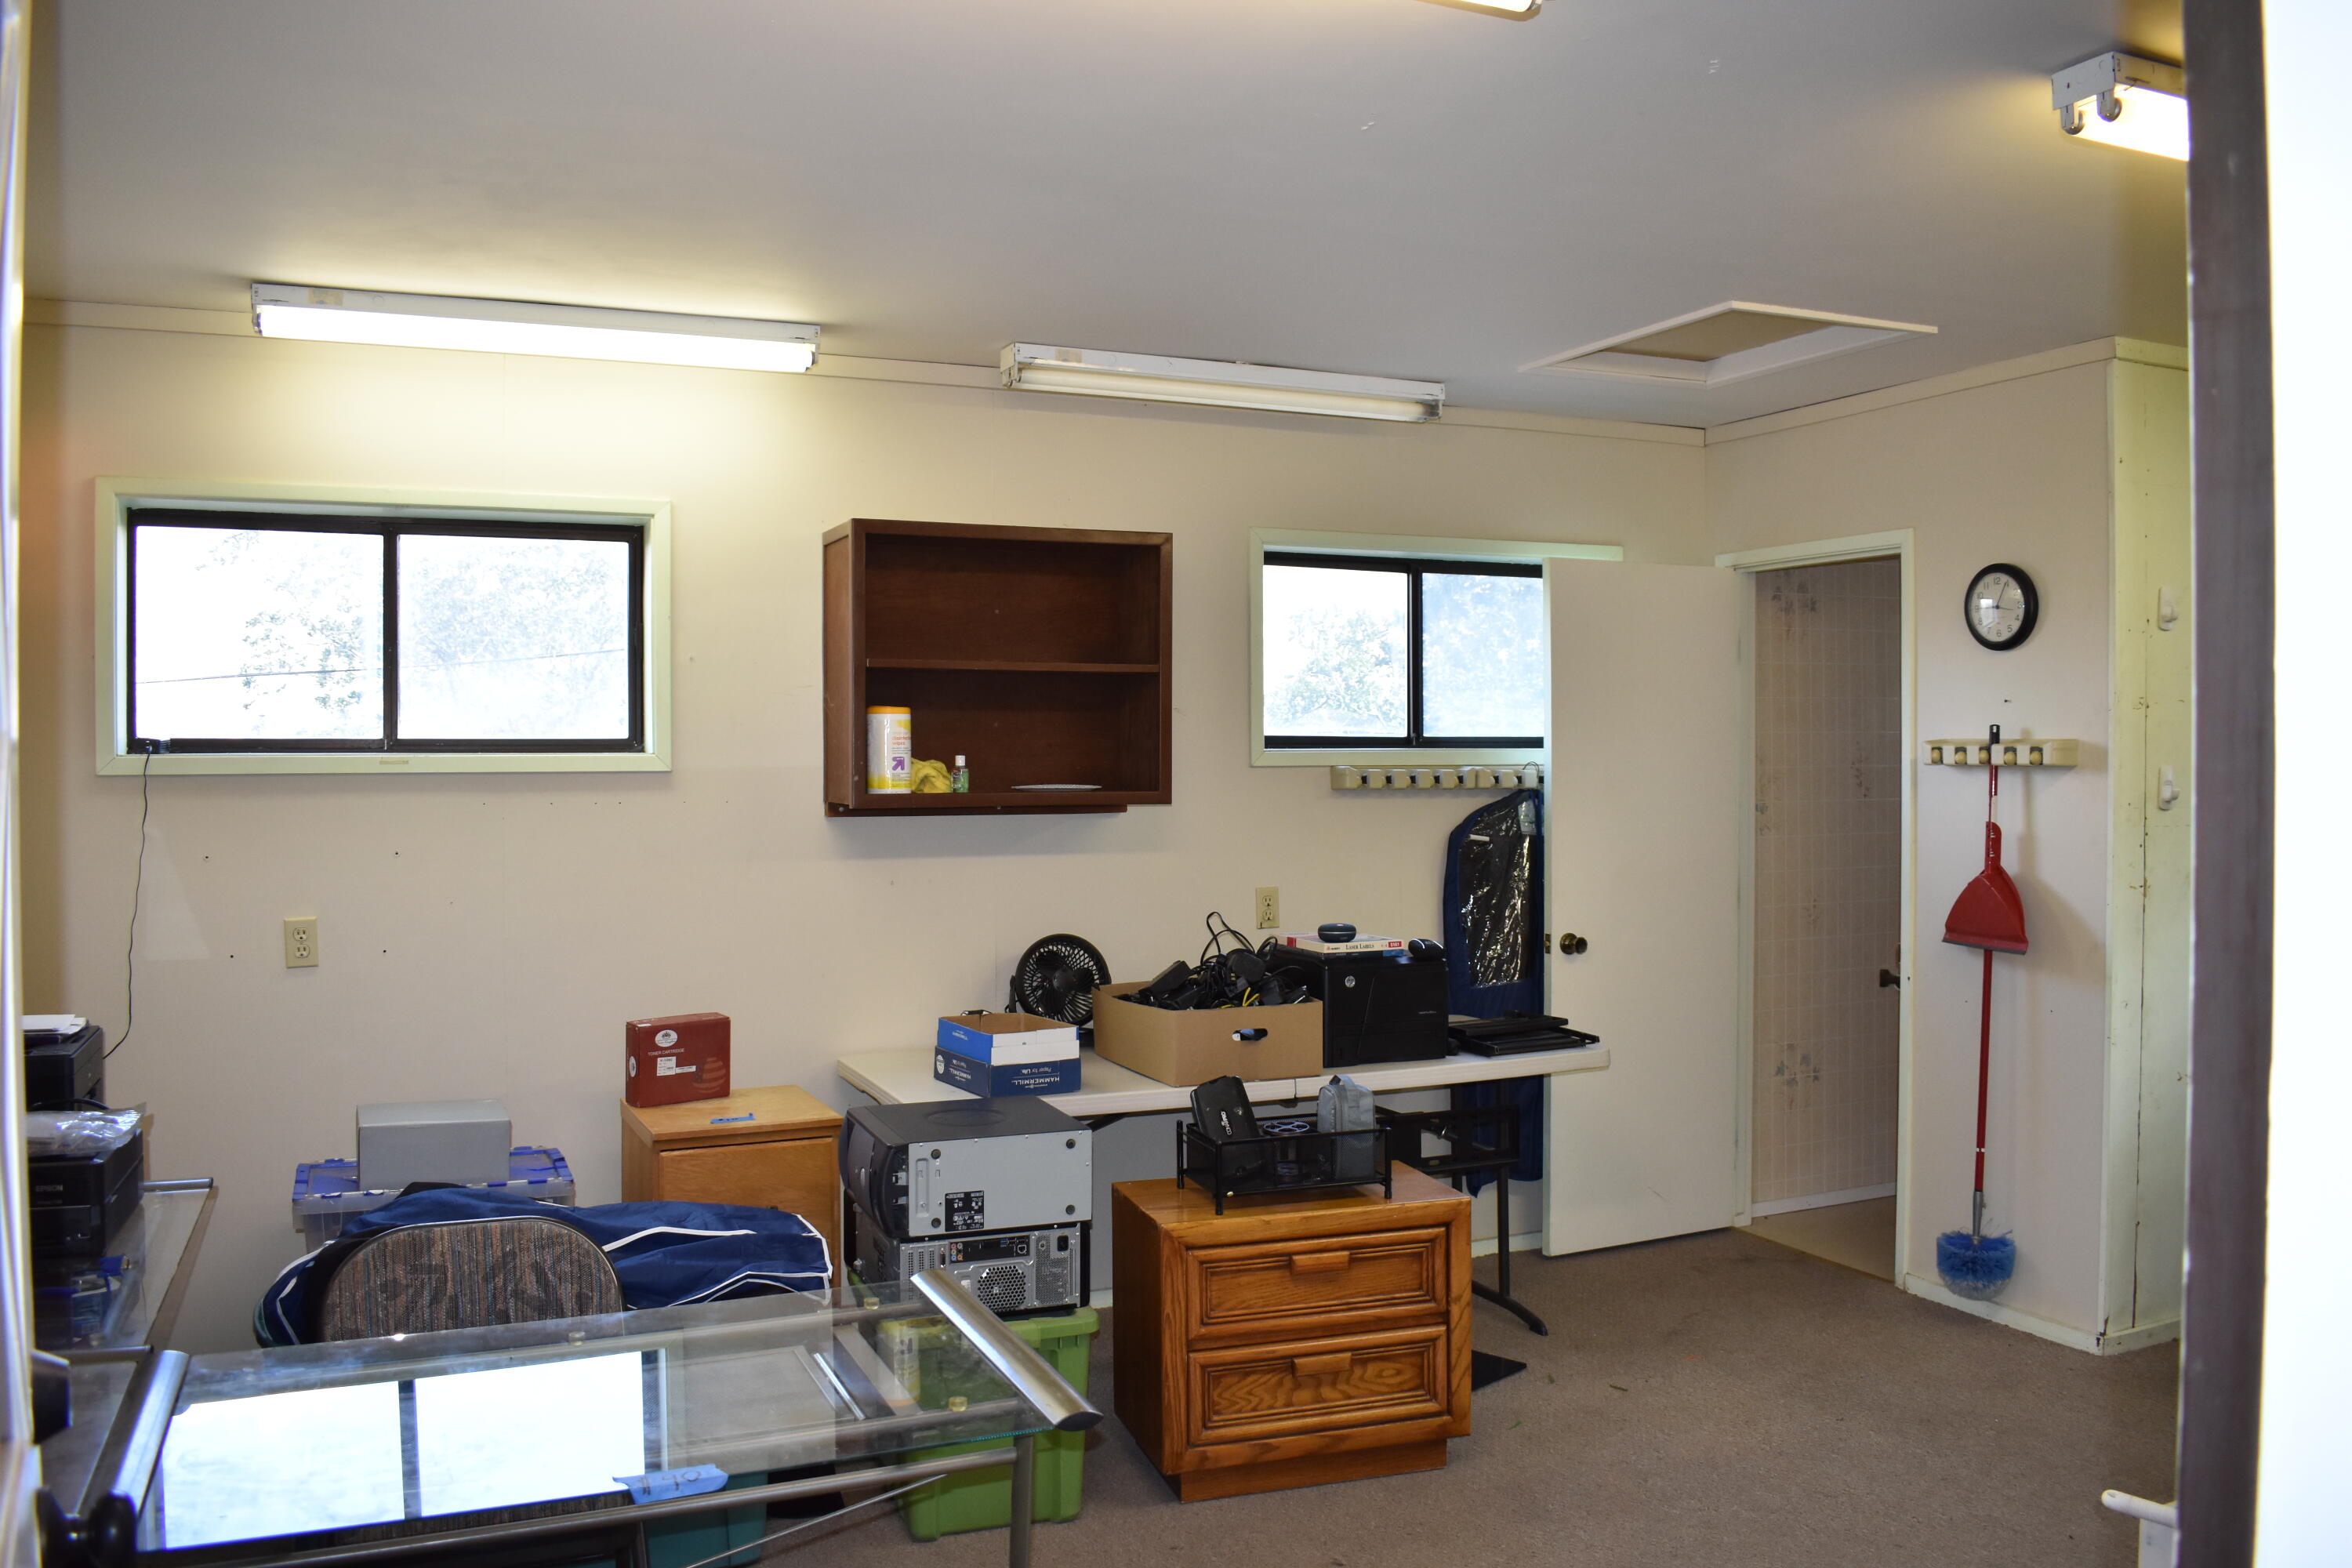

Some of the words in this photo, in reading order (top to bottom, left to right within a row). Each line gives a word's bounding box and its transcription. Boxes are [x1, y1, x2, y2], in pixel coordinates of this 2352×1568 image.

[1994, 576, 2001, 585] 12
[1983, 582, 1990, 590] 11
[1996, 629, 2002, 637] 6
[2007, 624, 2013, 633] 5
[1012, 1076, 1060, 1086] HAMMERMILL
